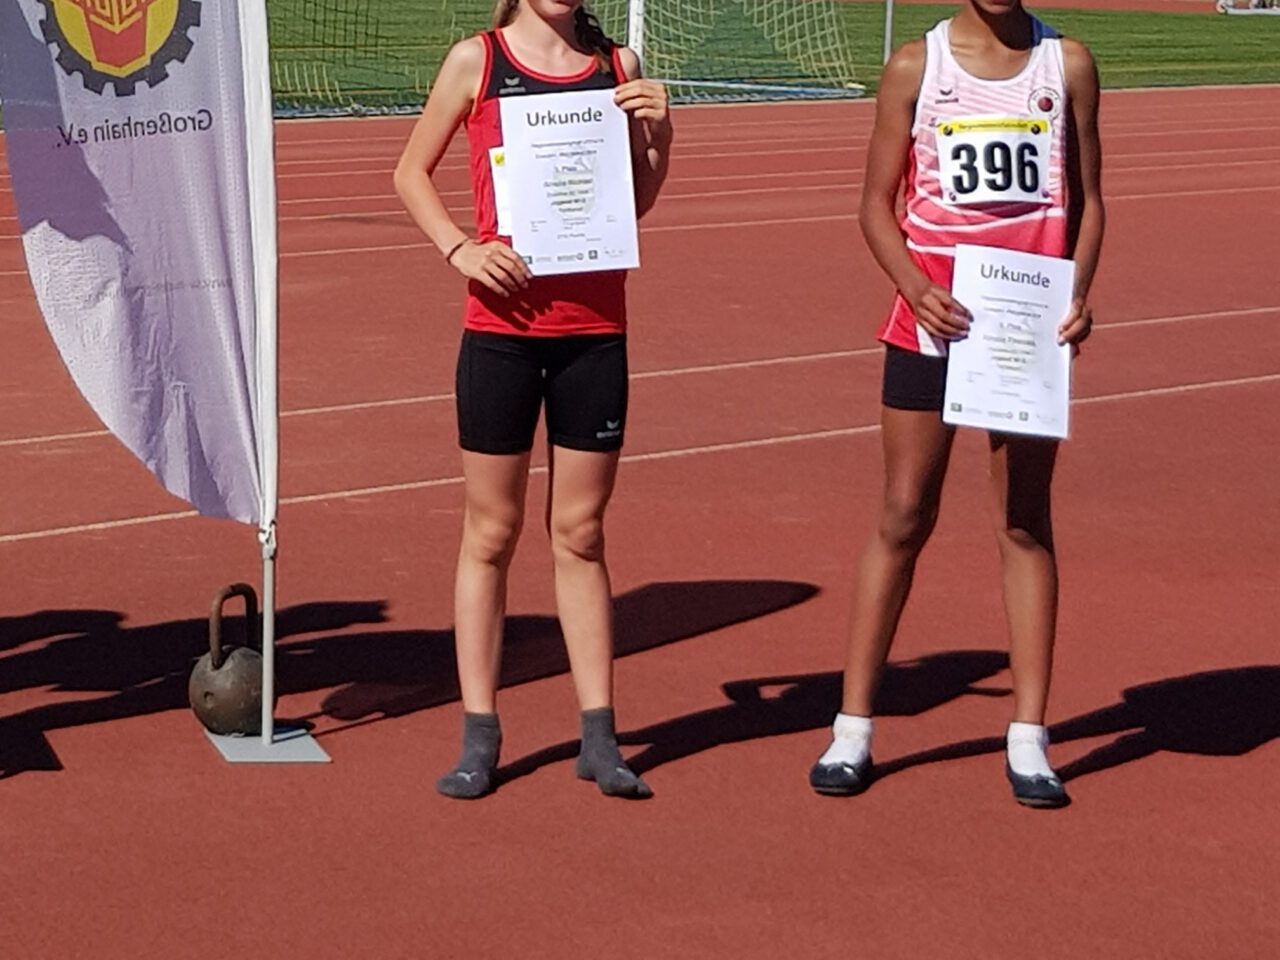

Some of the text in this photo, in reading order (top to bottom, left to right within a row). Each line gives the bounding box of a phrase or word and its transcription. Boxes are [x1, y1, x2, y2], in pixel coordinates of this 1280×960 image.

[526, 107, 603, 127] Urkunde
[951, 141, 1039, 194] 396
[980, 263, 1051, 289] Urkunde
